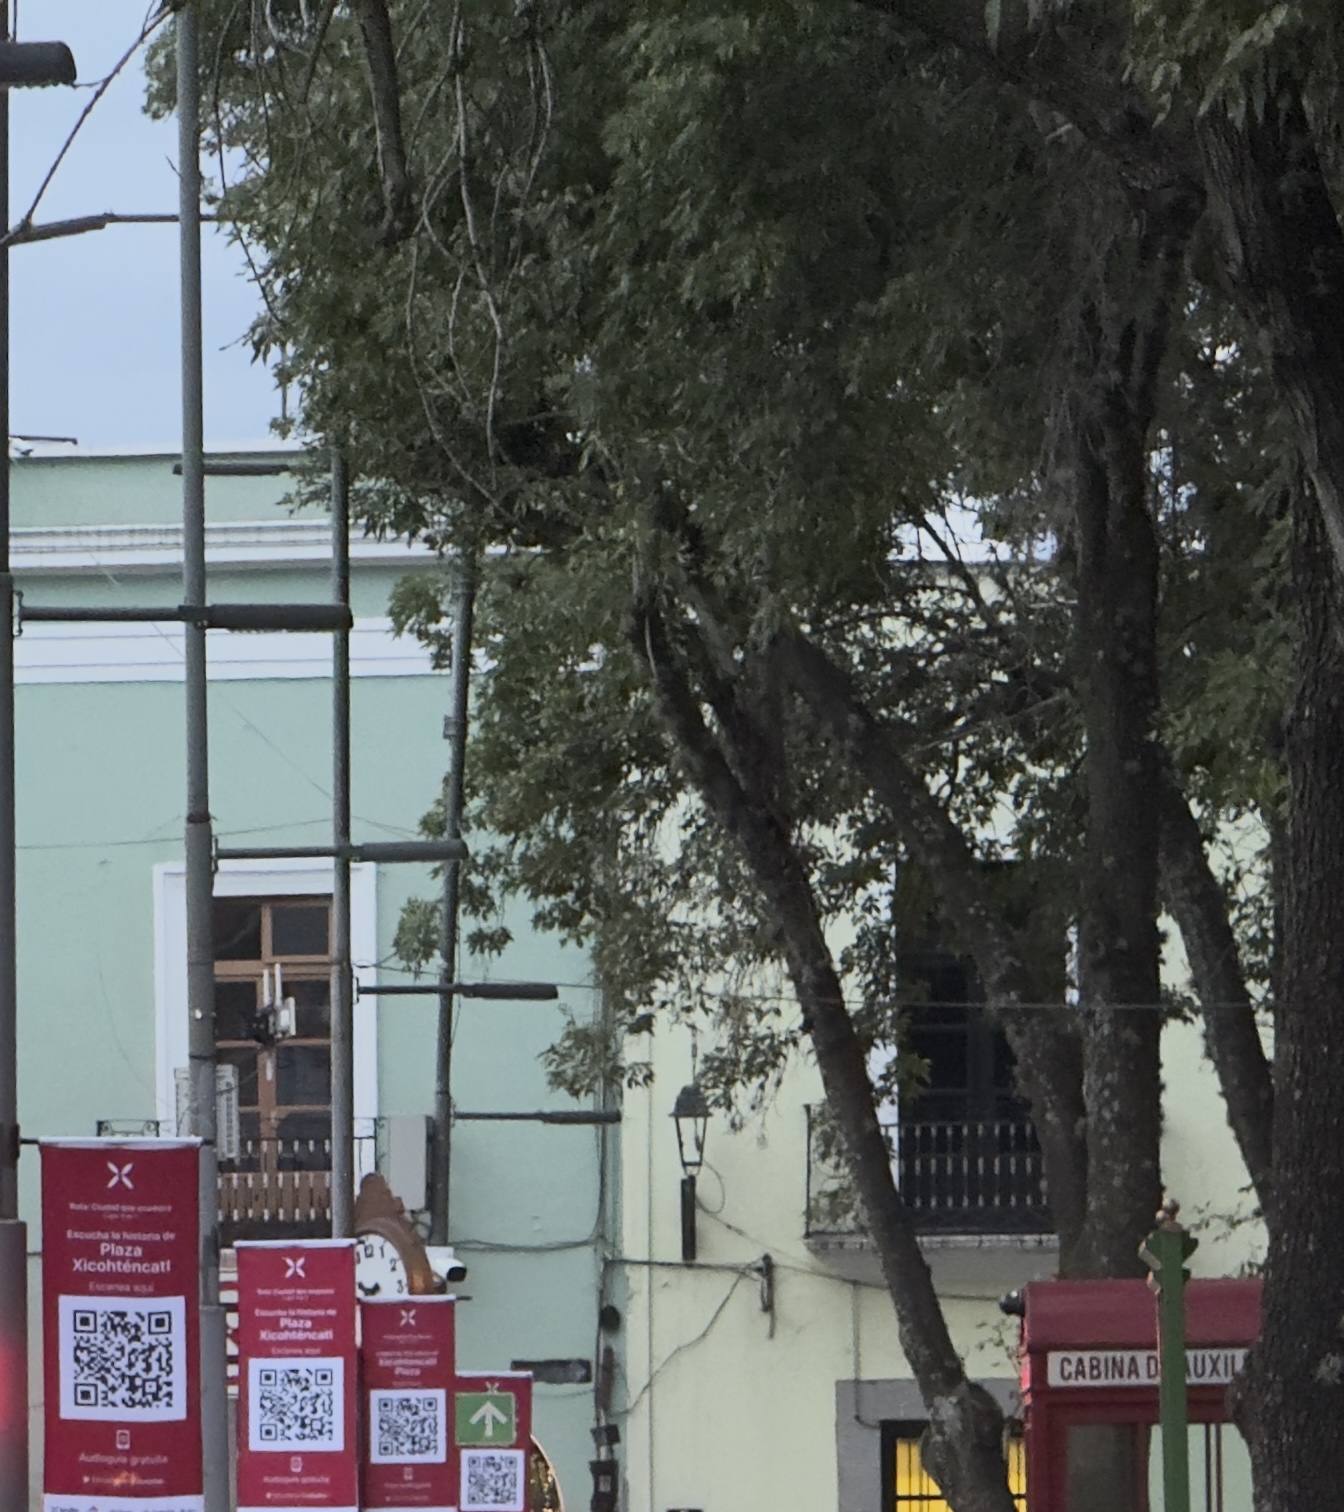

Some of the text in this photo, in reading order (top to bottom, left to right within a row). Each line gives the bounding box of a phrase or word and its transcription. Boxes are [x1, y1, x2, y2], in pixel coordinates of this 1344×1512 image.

[100, 1242, 143, 1257] Plaza
[73, 1258, 171, 1273] Xicohténcatl
[390, 1258, 397, 1272] 2
[397, 1279, 404, 1294] 3
[279, 1317, 312, 1329] Plaza
[1060, 1354, 1139, 1381] CABINA
